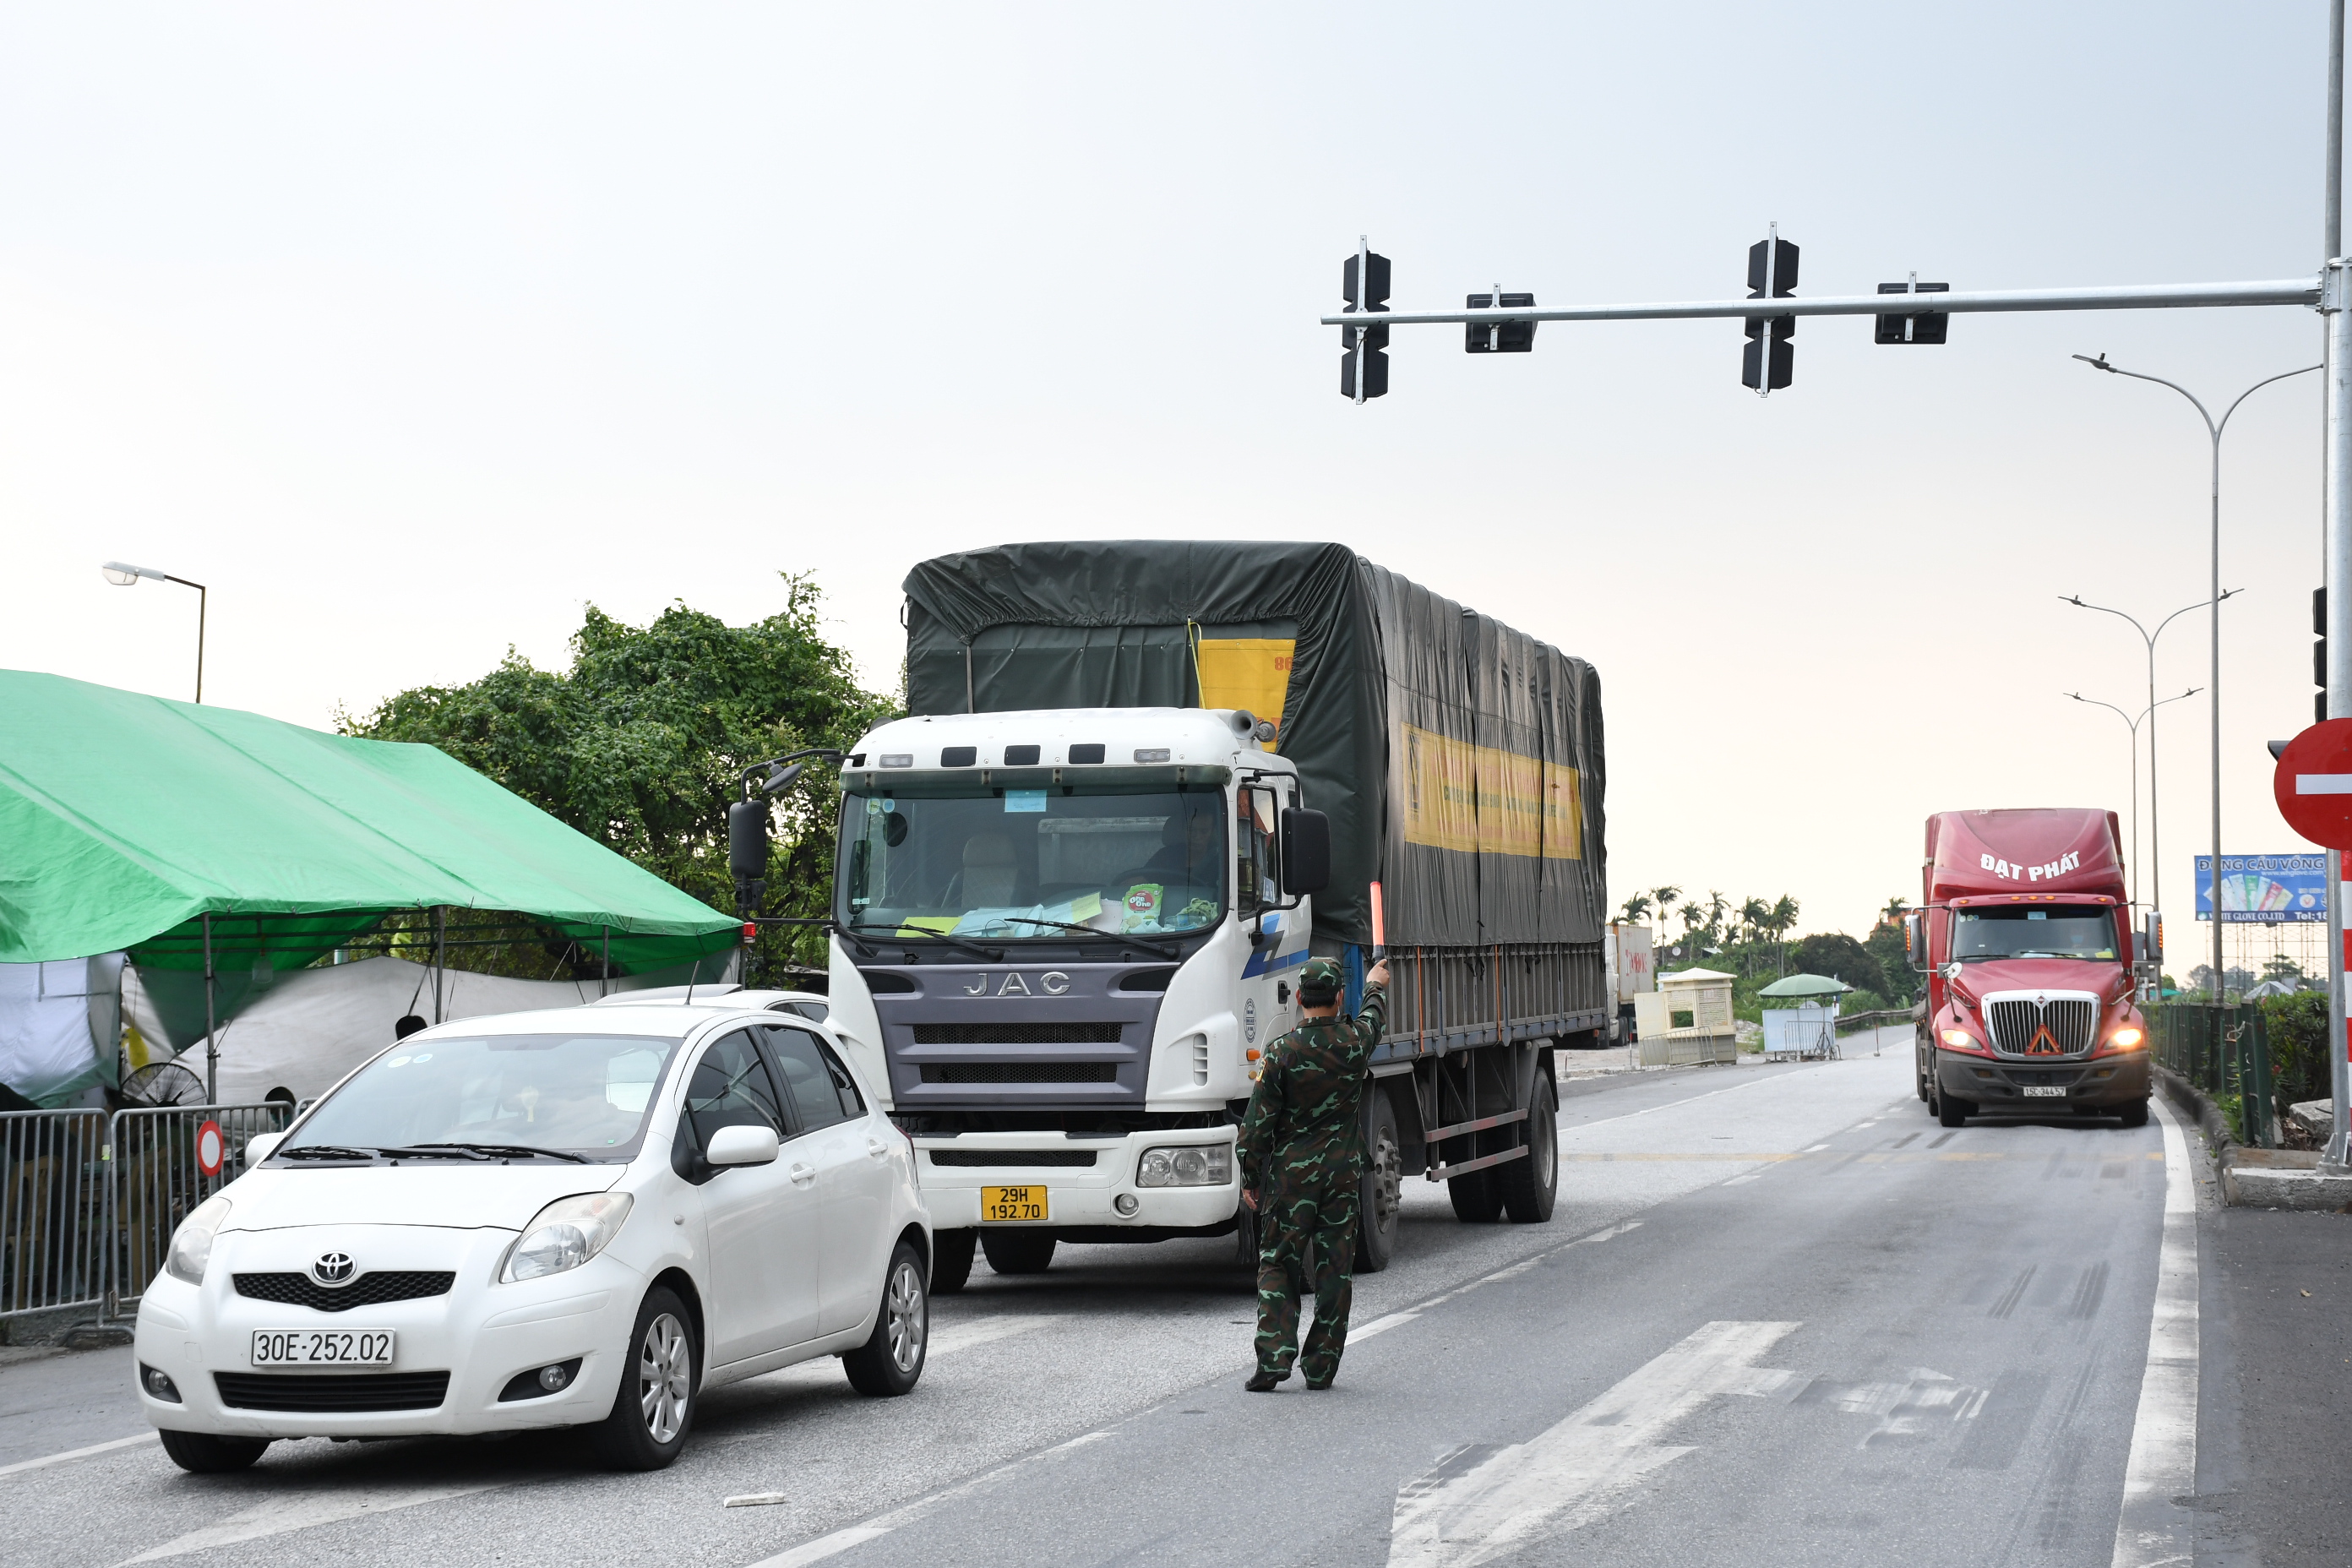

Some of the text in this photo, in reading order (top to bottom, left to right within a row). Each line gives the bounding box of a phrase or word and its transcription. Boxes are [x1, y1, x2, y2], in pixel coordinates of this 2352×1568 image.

[1979, 850, 2080, 882] ĐẠT PHÁT
[2198, 858, 2244, 871] ĐNG
[2232, 912, 2257, 921] GLOVE
[963, 971, 1071, 997] JAC
[999, 1188, 1028, 1203] 29H
[990, 1204, 1041, 1219] 192.70
[256, 1333, 389, 1361] 30E-252.02
